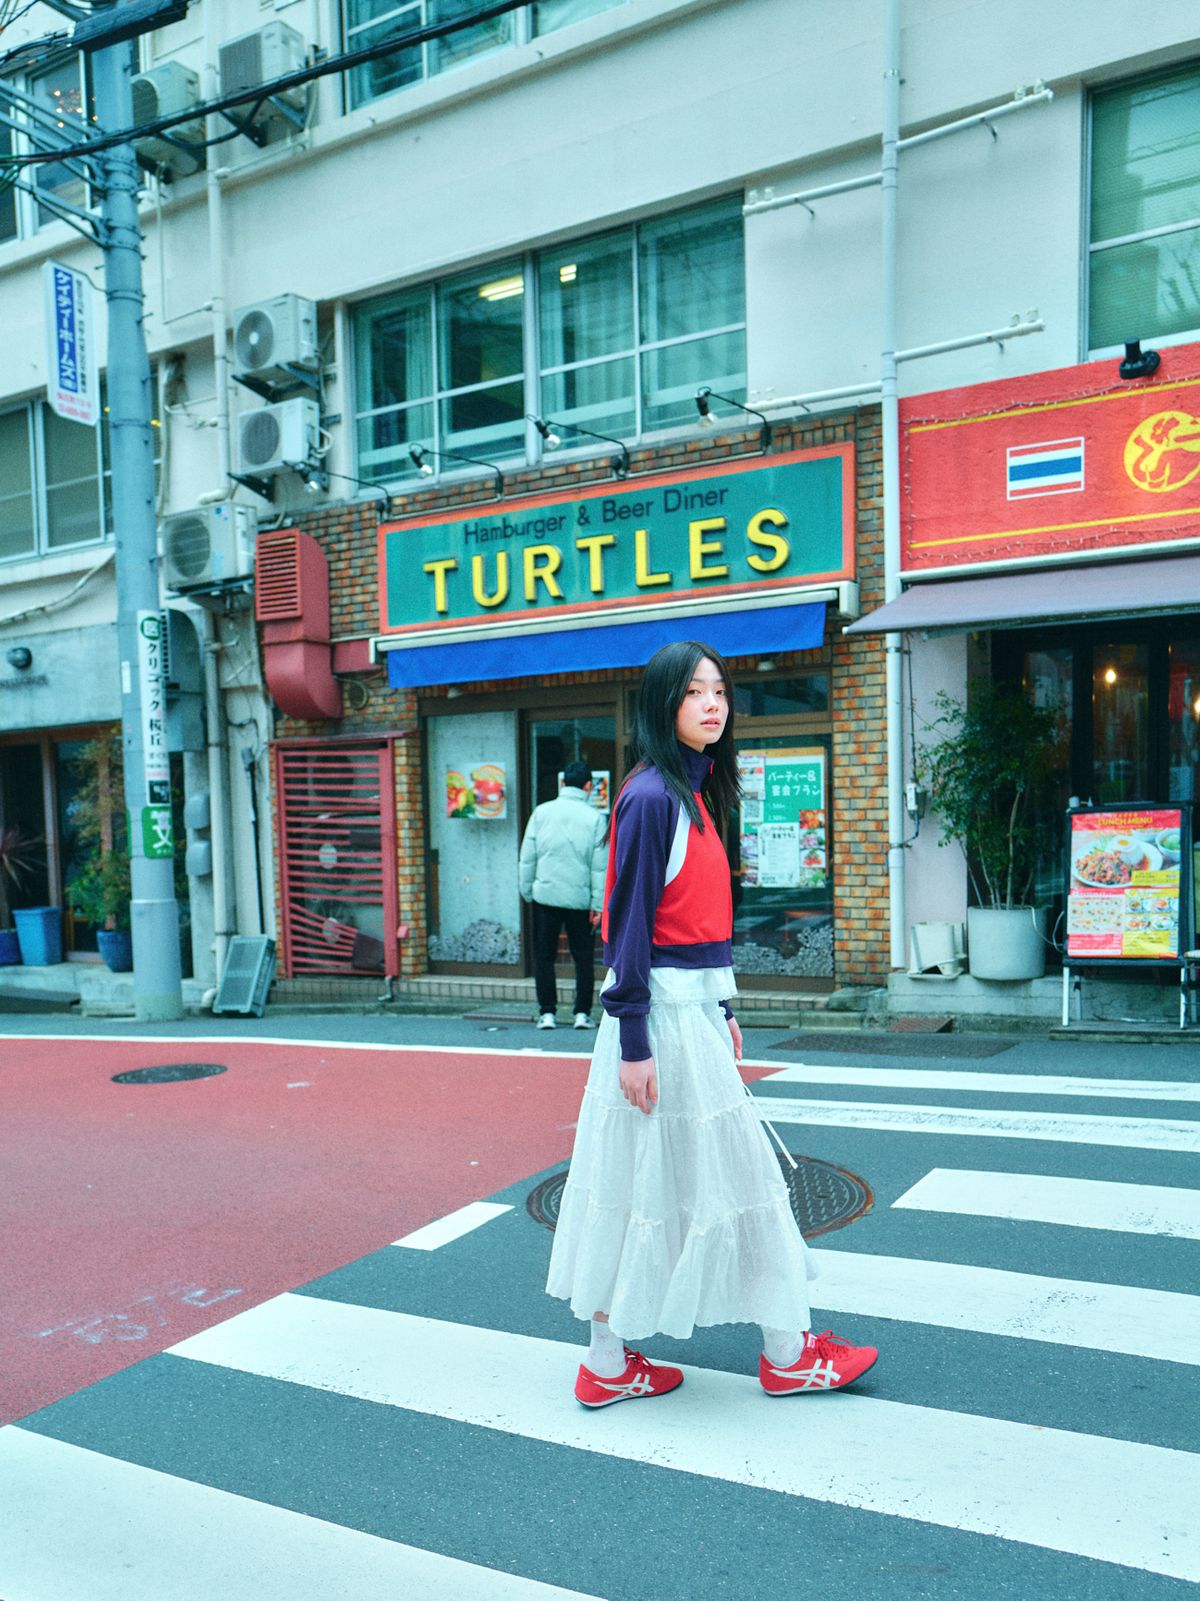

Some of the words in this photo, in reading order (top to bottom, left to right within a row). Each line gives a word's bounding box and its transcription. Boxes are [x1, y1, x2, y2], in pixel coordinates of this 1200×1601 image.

[464, 513, 566, 545] Hamburger
[577, 506, 591, 527] &
[602, 499, 653, 523] Beer
[664, 486, 729, 513] Diner
[423, 508, 790, 613] TURTLES
